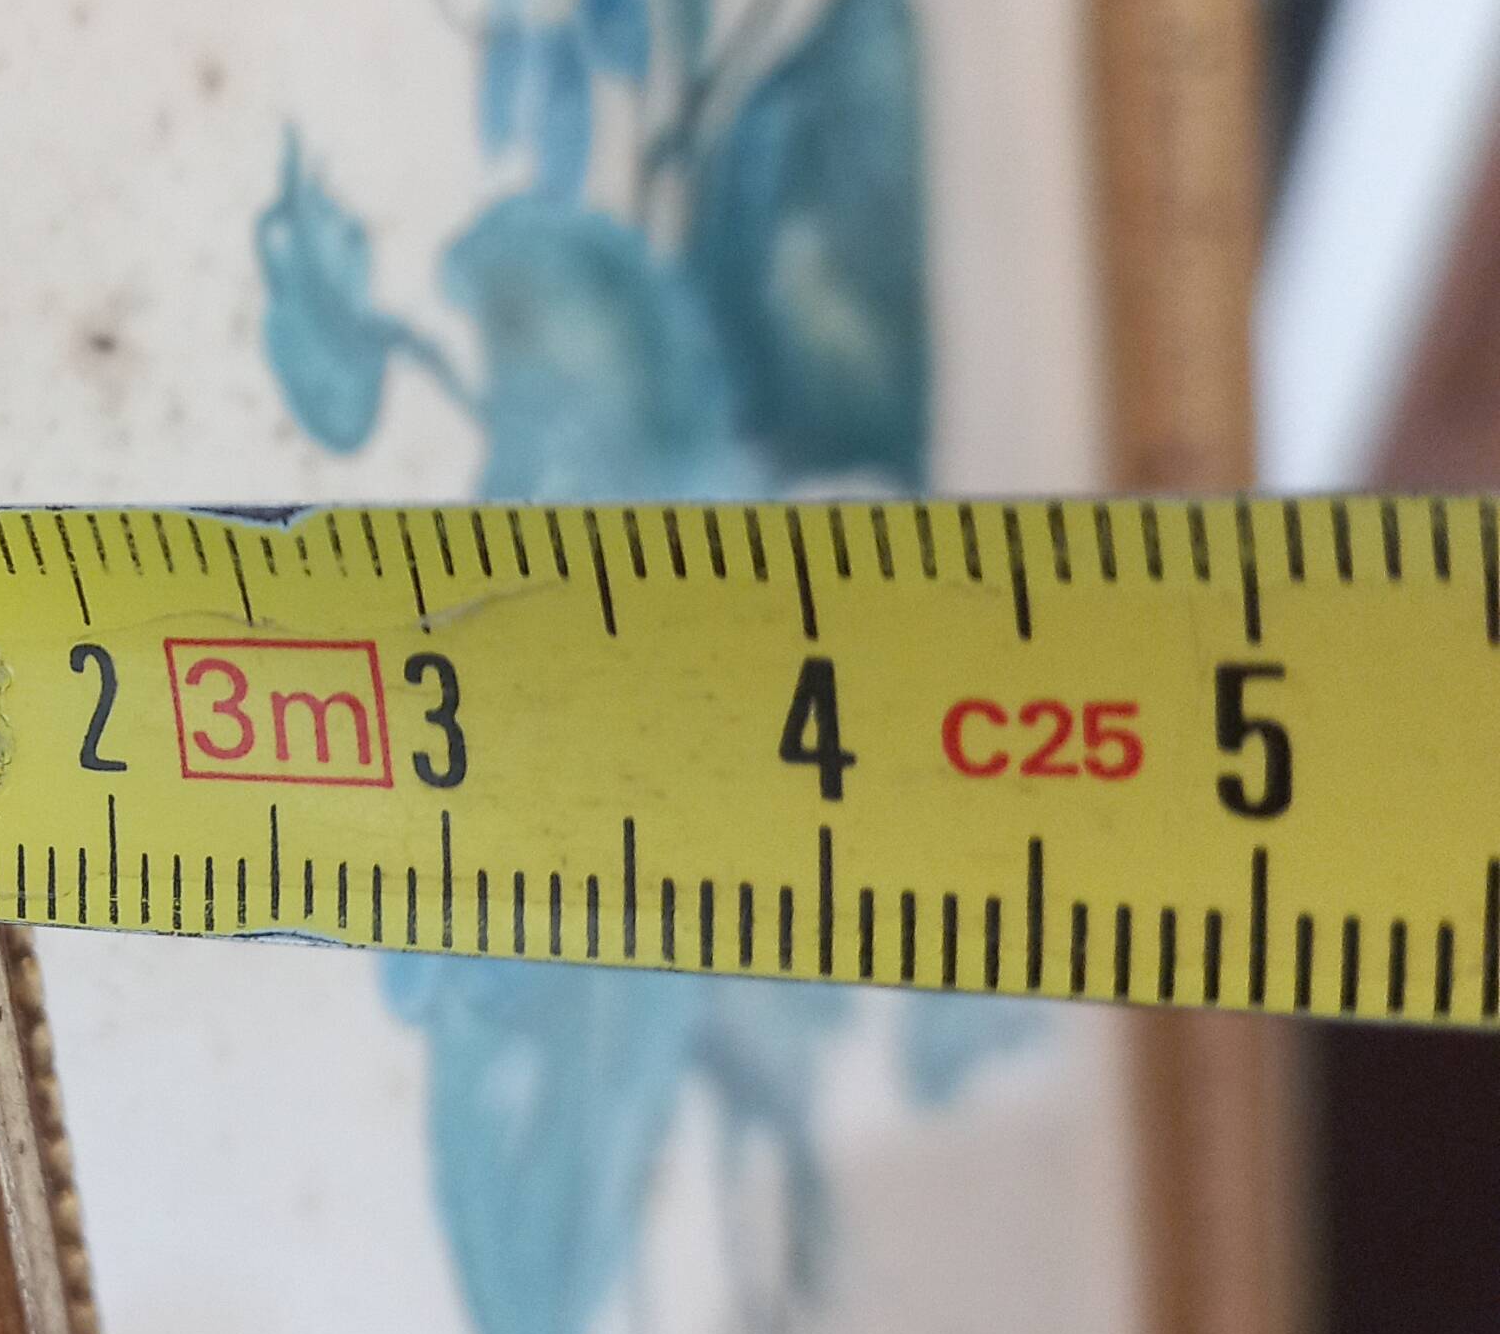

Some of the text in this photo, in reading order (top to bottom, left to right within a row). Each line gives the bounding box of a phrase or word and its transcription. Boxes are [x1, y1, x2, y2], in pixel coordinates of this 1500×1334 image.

[68, 642, 128, 772] 2
[184, 656, 373, 766] 3m
[403, 651, 468, 789] 3
[778, 656, 857, 802] 4
[941, 698, 1145, 782] C25
[1214, 660, 1294, 820] 5
